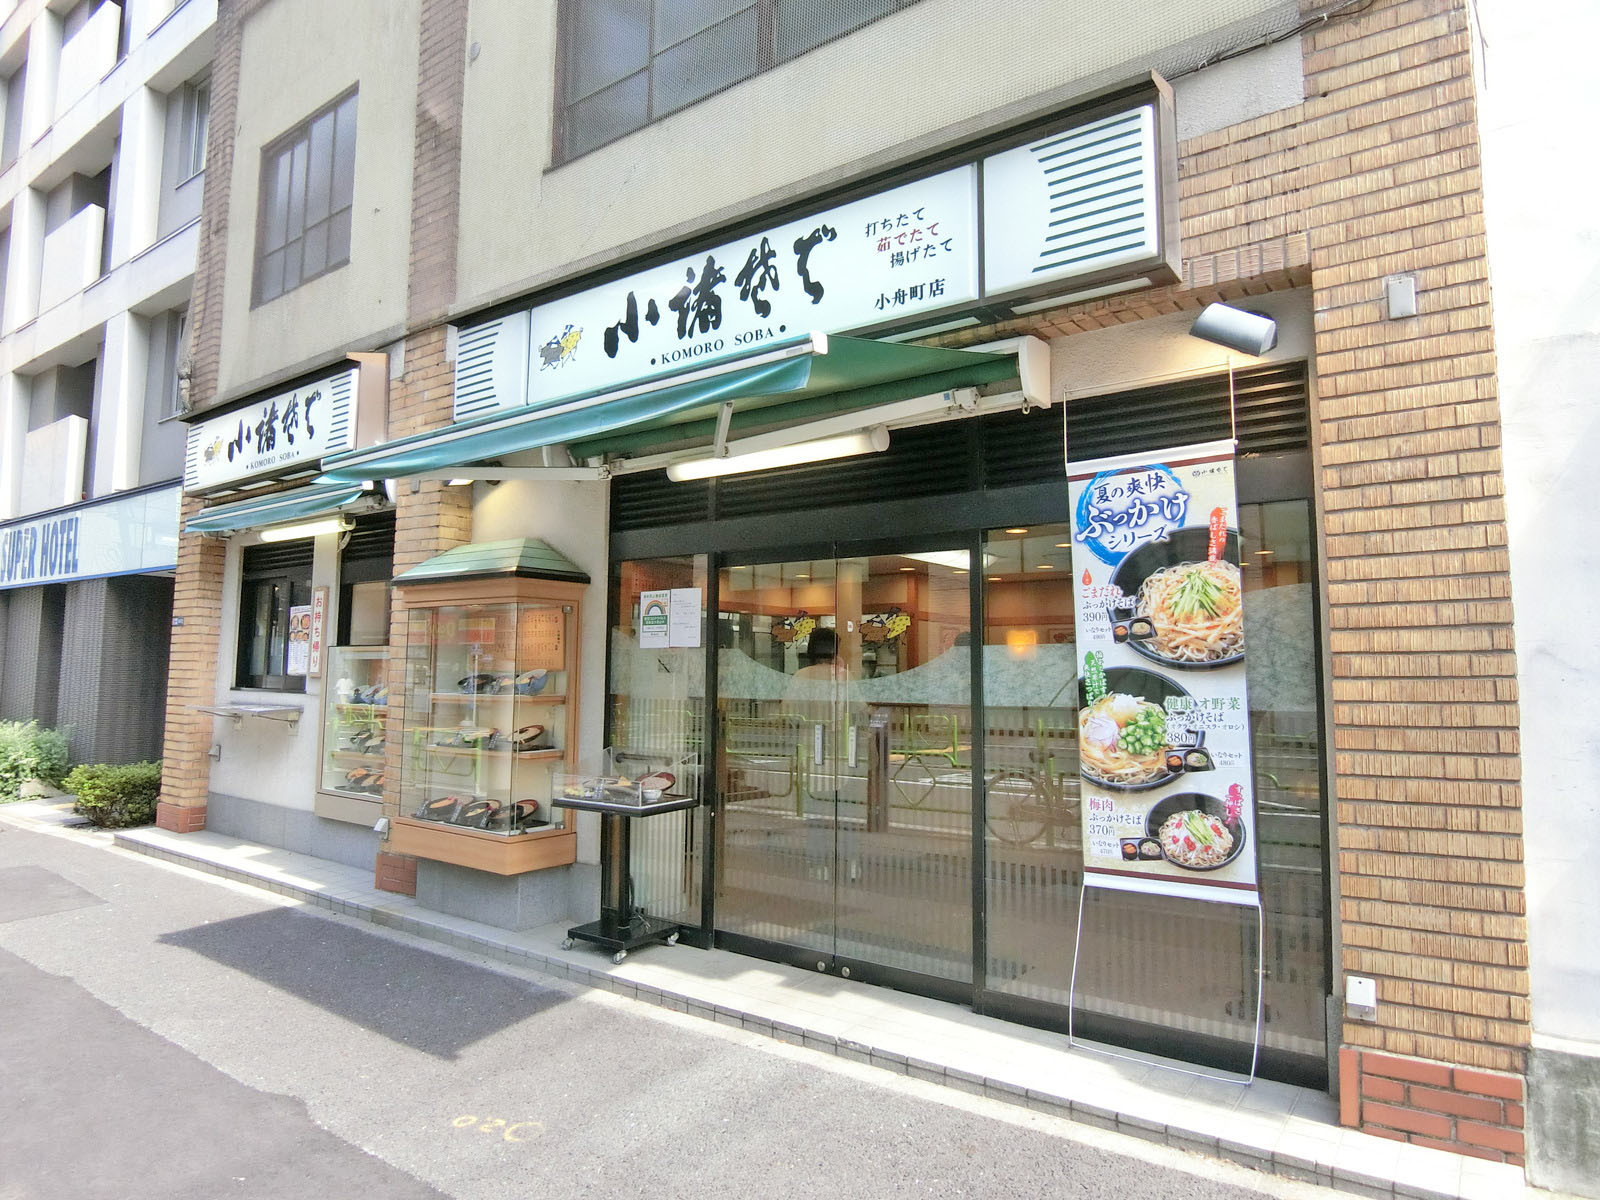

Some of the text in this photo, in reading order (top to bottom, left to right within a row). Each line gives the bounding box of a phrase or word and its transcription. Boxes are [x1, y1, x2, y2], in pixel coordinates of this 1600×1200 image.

[865, 207, 925, 238] 打ちたて
[877, 222, 940, 253] 茹でたて
[890, 238, 953, 268] 揚げたて
[874, 278, 946, 311] 小舟町店
[661, 326, 775, 365] KOMORO SOBA
[250, 451, 296, 470] KOMORO SOBA
[1094, 472, 1166, 505] 夏の爽快
[1076, 492, 1189, 542] ぶっかけ
[1107, 524, 1169, 550] シリーズ
[0, 517, 79, 583] SUPER HOTEL
[1081, 585, 1121, 599] ごまだれ
[1082, 596, 1135, 610] ぶっかけそば
[1083, 611, 1108, 622] 390円
[1165, 696, 1192, 711] 健康
[1166, 711, 1226, 723] ぶっかけそば
[1166, 732, 1196, 744] 380円
[1089, 798, 1114, 812] 梅肉
[1088, 813, 1143, 825] ぶっかけそば
[1089, 824, 1116, 836] 370円
